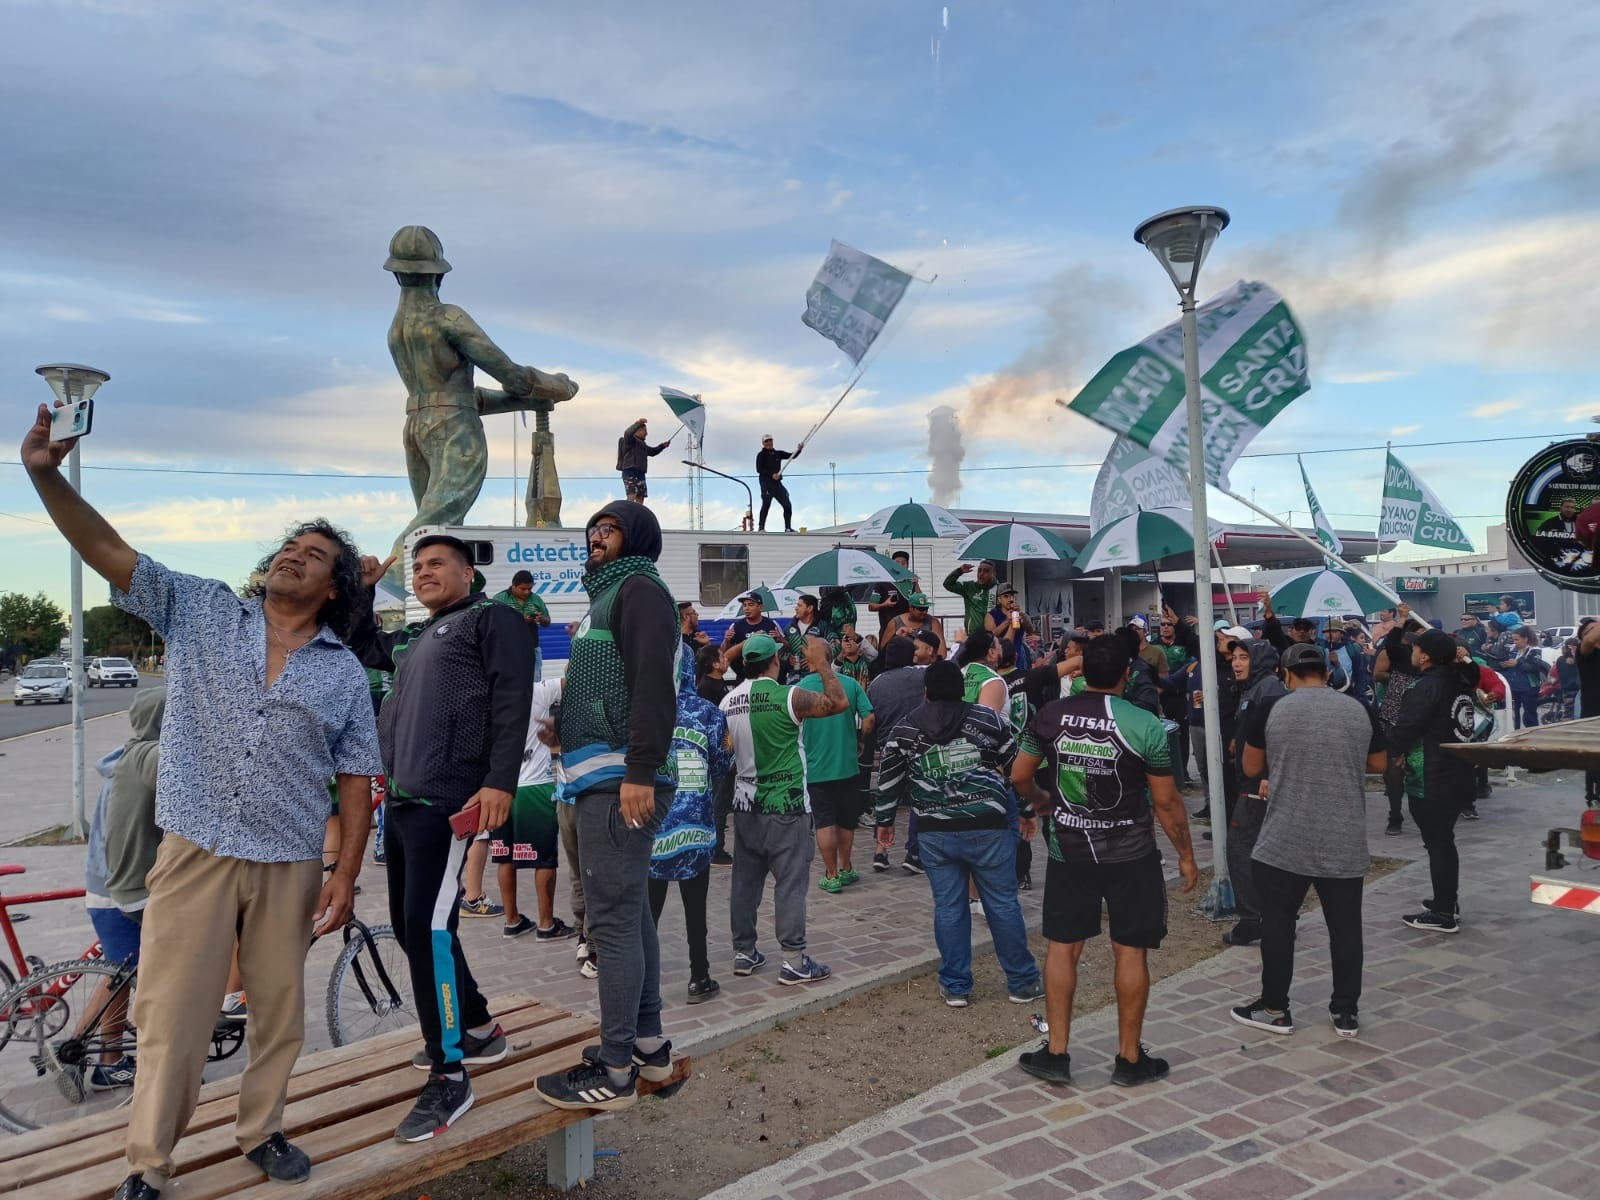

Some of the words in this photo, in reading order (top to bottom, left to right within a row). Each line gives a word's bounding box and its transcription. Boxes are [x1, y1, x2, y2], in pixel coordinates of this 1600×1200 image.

[1219, 318, 1295, 394] SANTA
[1547, 531, 1577, 539] BANDA
[729, 693, 749, 707] SANTA
[751, 692, 770, 704] CRUZ
[1060, 714, 1115, 732] FUTSAL
[1060, 741, 1114, 758] CAMIONEROS
[1067, 755, 1107, 769] FUTSAL
[441, 983, 454, 1030] TOPPER
